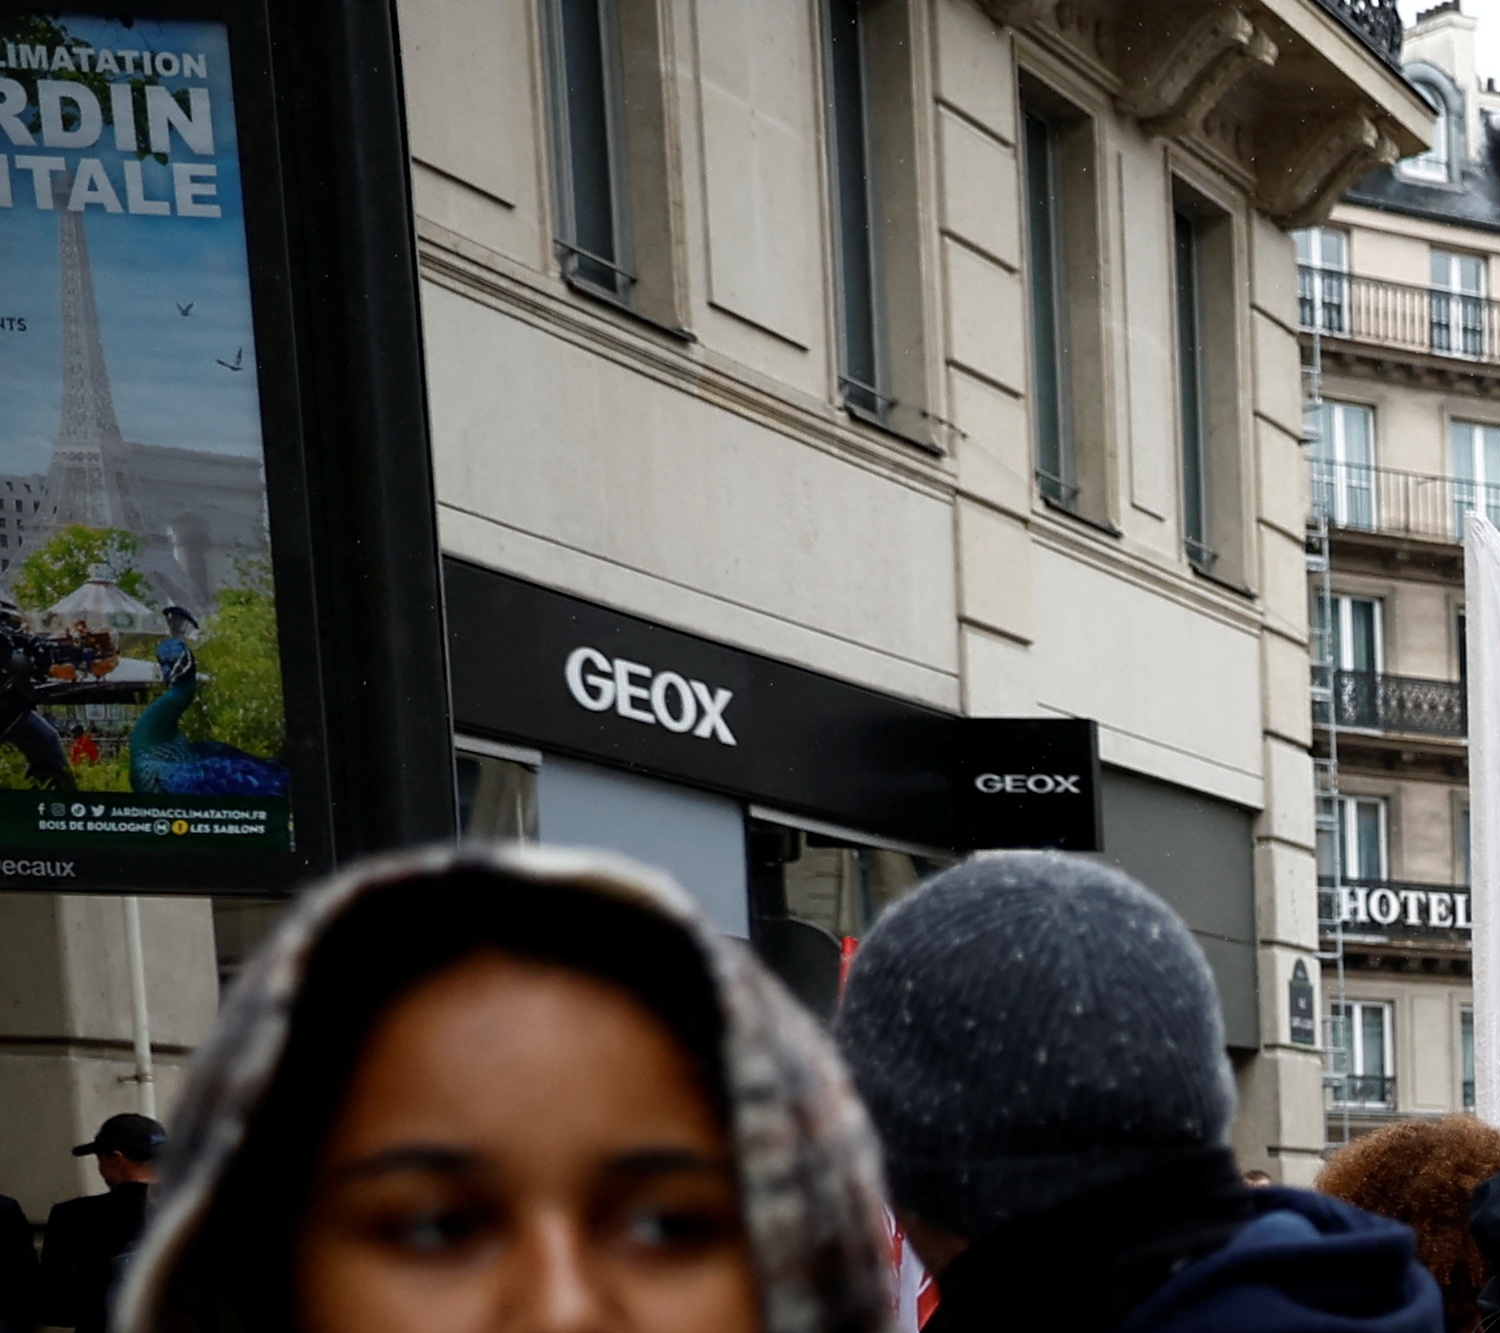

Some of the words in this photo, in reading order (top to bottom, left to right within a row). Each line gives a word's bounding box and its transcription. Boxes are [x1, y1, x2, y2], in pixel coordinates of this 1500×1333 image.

[0, 43, 208, 79] IMATATION
[564, 646, 738, 747] GEOX
[974, 773, 1081, 795] GEOX
[0, 857, 77, 878] ecaux
[1337, 886, 1472, 929] HOTEL
